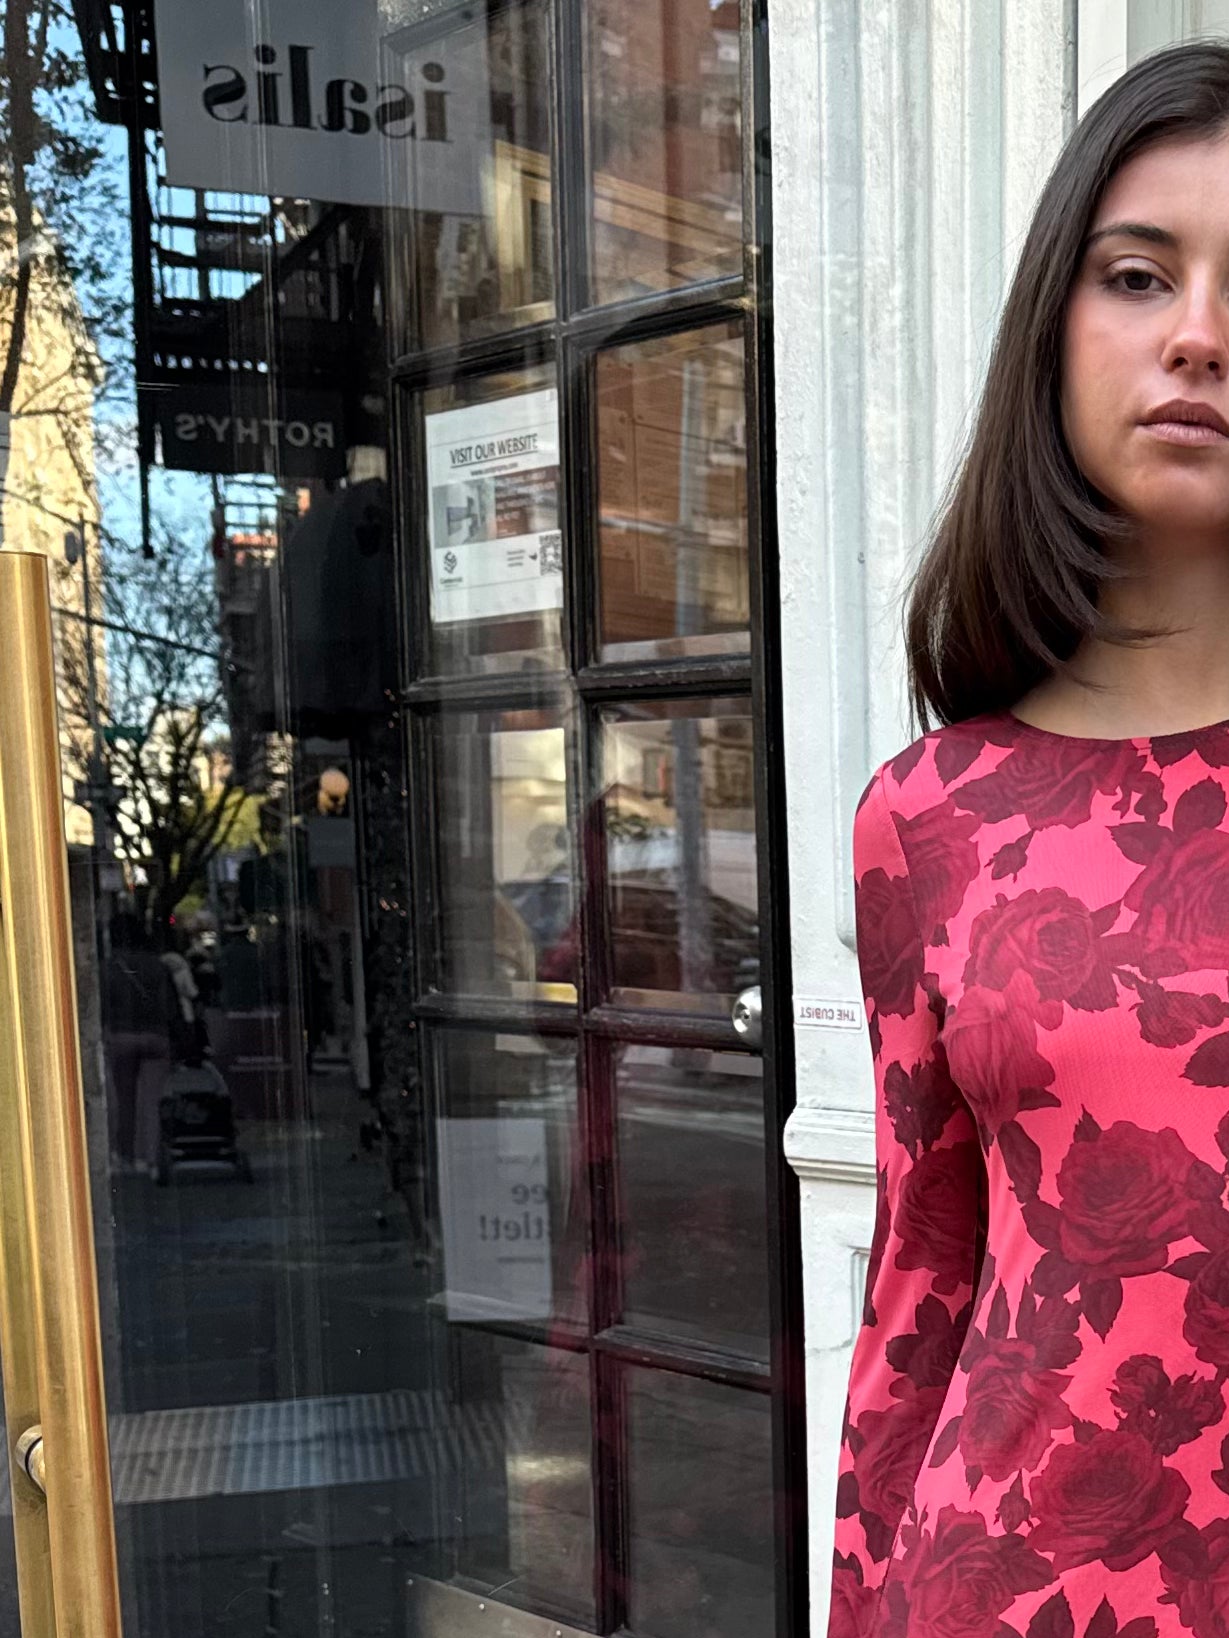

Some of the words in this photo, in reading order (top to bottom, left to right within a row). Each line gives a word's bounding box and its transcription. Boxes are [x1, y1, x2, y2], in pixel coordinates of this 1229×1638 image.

[449, 446, 473, 464] VISIT
[475, 441, 496, 460] OUR
[497, 433, 539, 456] WEBSITE
[800, 1006, 835, 1019] CUBIST
[837, 1009, 856, 1021] THE
